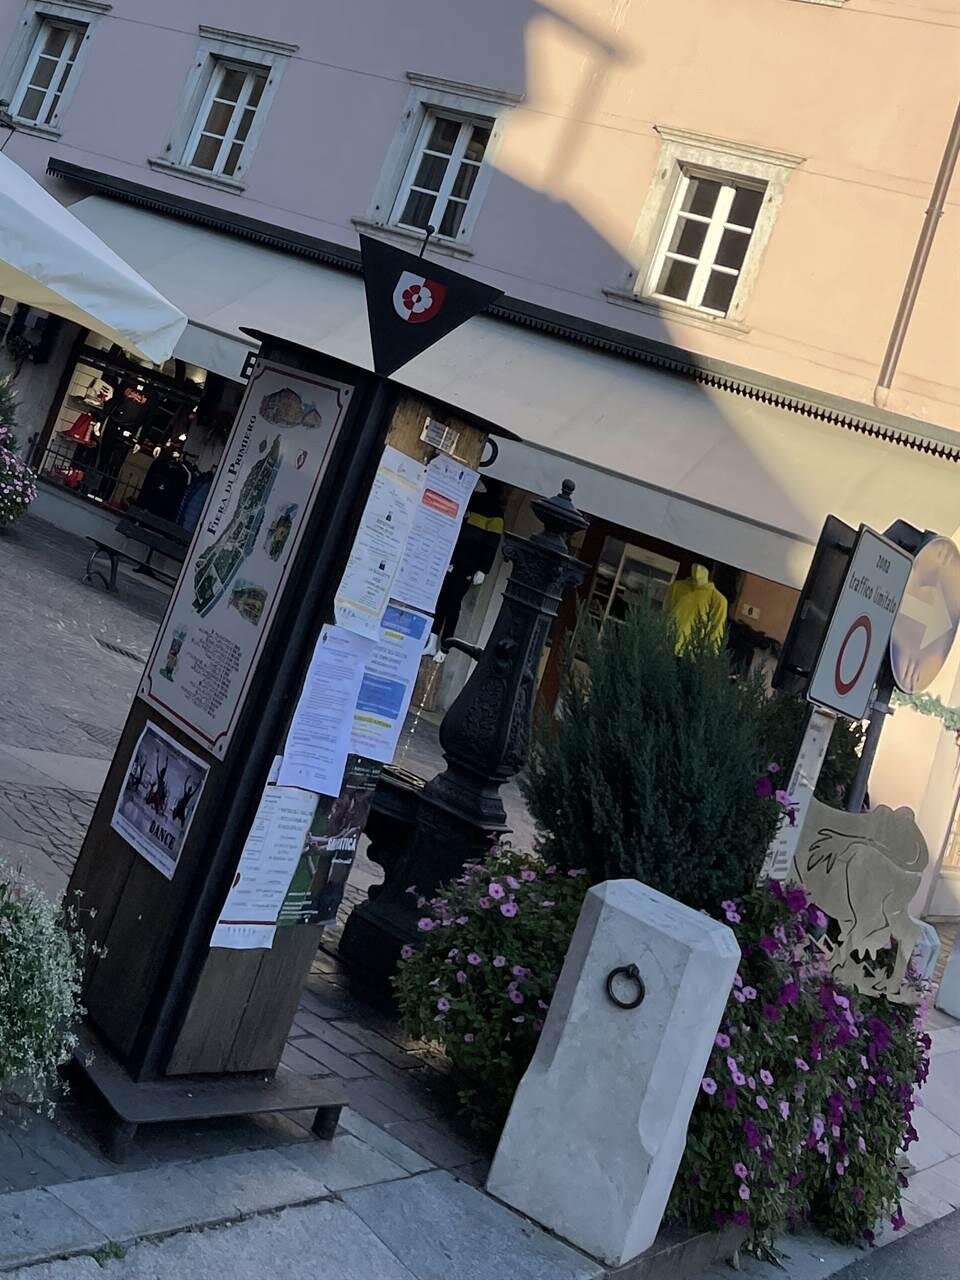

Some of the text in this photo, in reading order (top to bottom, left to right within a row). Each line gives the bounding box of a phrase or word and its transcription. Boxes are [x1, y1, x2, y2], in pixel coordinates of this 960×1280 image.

[207, 415, 257, 536] FIERA DI PRIMIERO
[876, 554, 890, 573] zona
[848, 570, 897, 615] traffico limitato
[149, 820, 177, 851] DANCE
